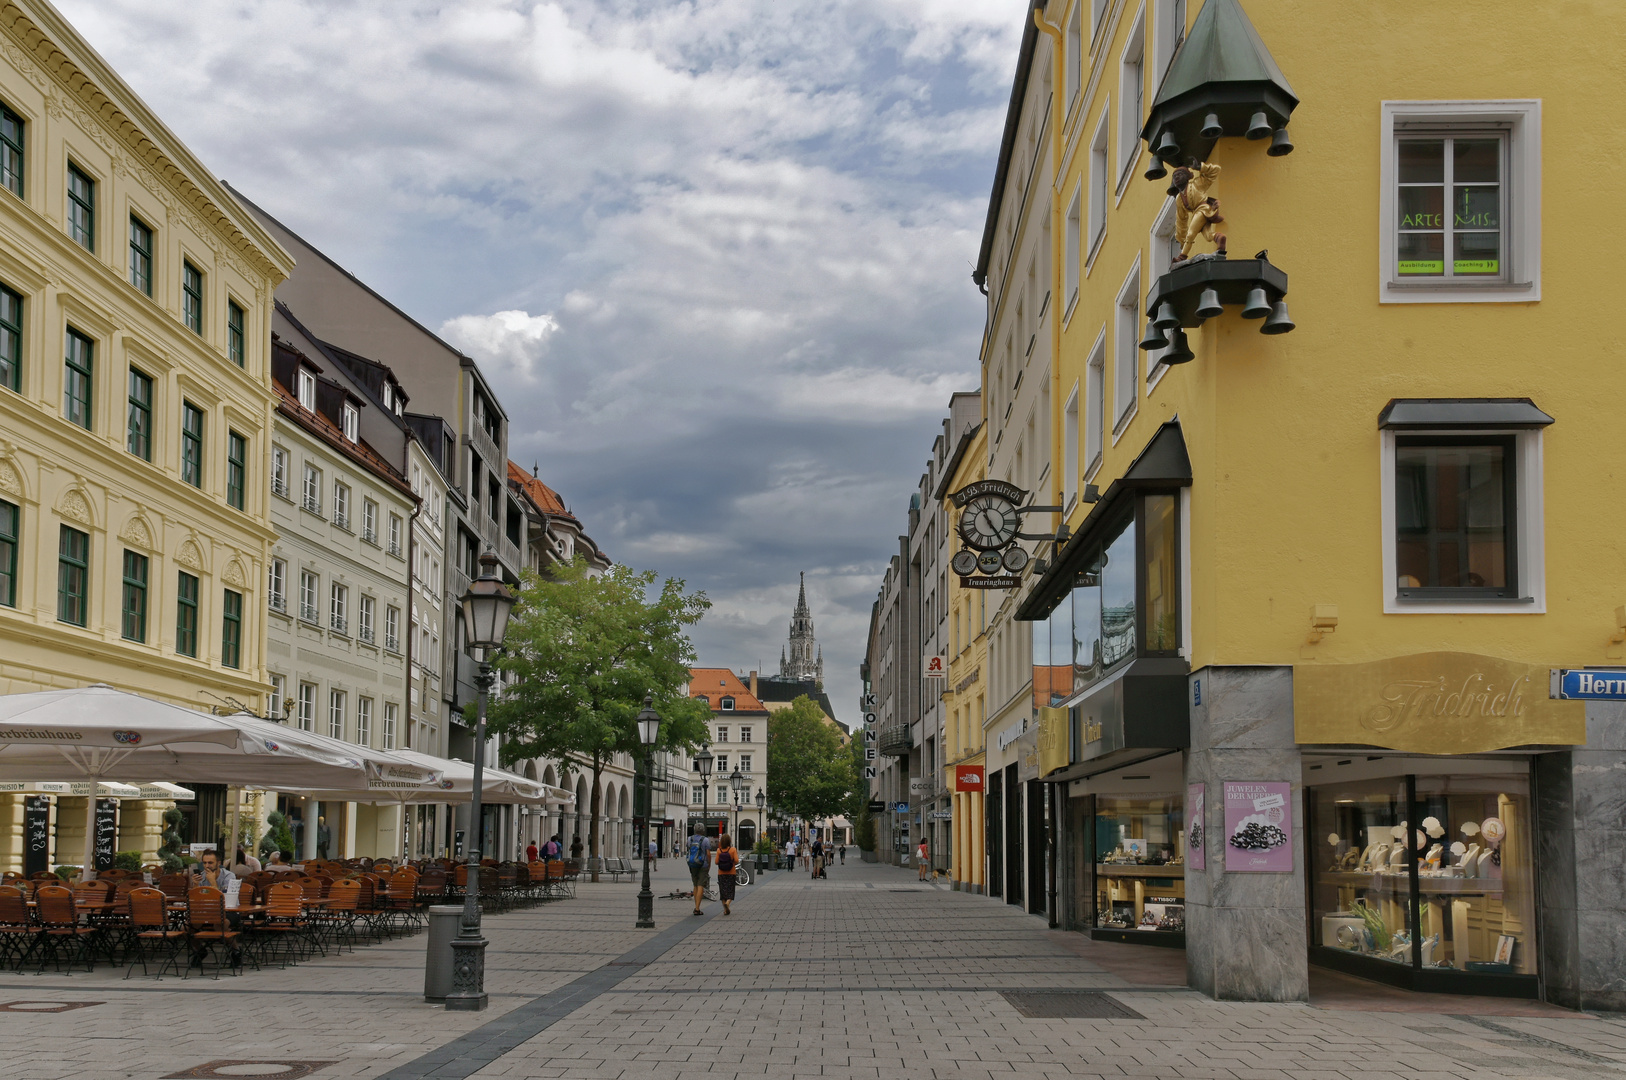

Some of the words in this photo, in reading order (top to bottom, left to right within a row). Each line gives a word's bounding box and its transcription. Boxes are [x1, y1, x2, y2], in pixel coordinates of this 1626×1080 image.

[967, 486, 980, 497] B.
[981, 482, 1020, 501] Fridrich
[968, 578, 1014, 587] Trauringhaus
[1360, 673, 1530, 733] Fridrich
[865, 694, 877, 778] KONEN
[1227, 785, 1267, 793] JUWELEN
[1227, 792, 1245, 800] DER
